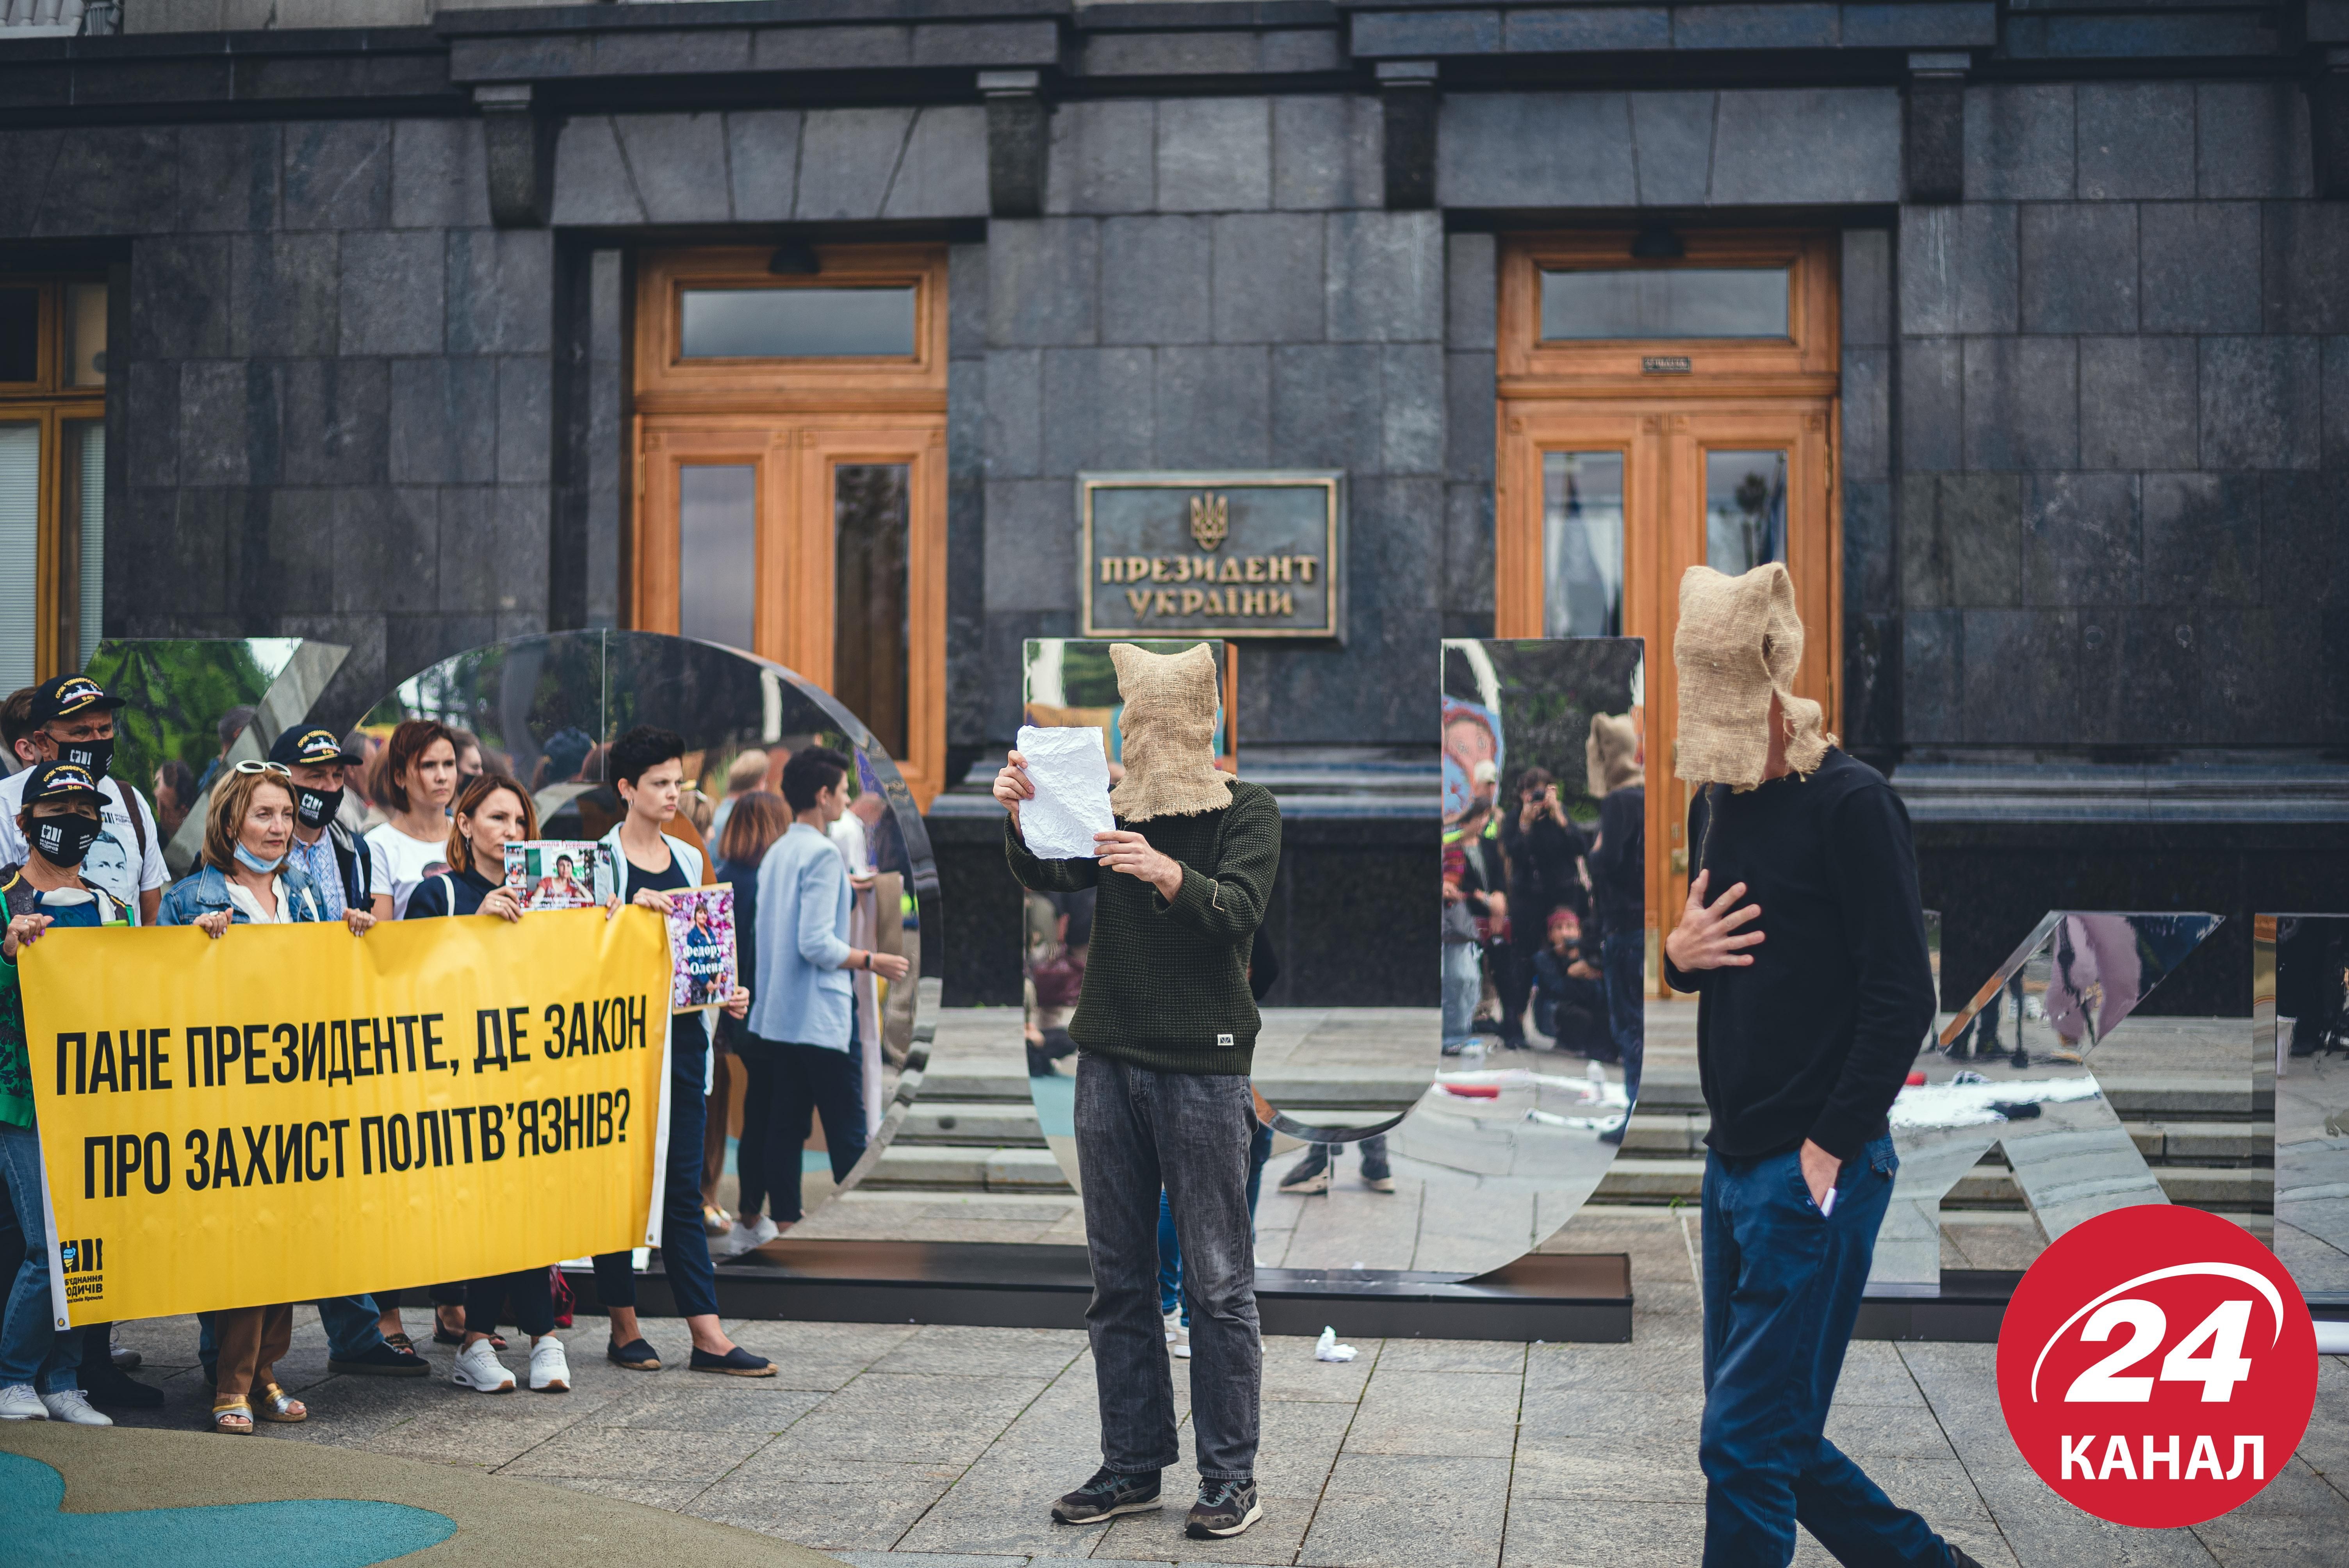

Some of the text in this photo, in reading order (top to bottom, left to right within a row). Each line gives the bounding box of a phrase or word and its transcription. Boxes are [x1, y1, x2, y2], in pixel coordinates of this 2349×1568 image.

[1100, 554, 1319, 584] ПРЕЗИДЕНТ
[1126, 587, 1294, 622] УКРАЇНИ
[690, 961, 725, 976] Олена
[57, 995, 646, 1096] ПАНЕ ПРЕЗИДЕНТЕ, ДЕ ЗАКОН
[84, 1089, 630, 1199] ПРО ЗАХИСТ ПОЛІТВ’ЯЗНІВ?
[65, 1274, 103, 1286] Б'ЄДНАННЯ
[65, 1283, 103, 1298] ОДИЧІВ
